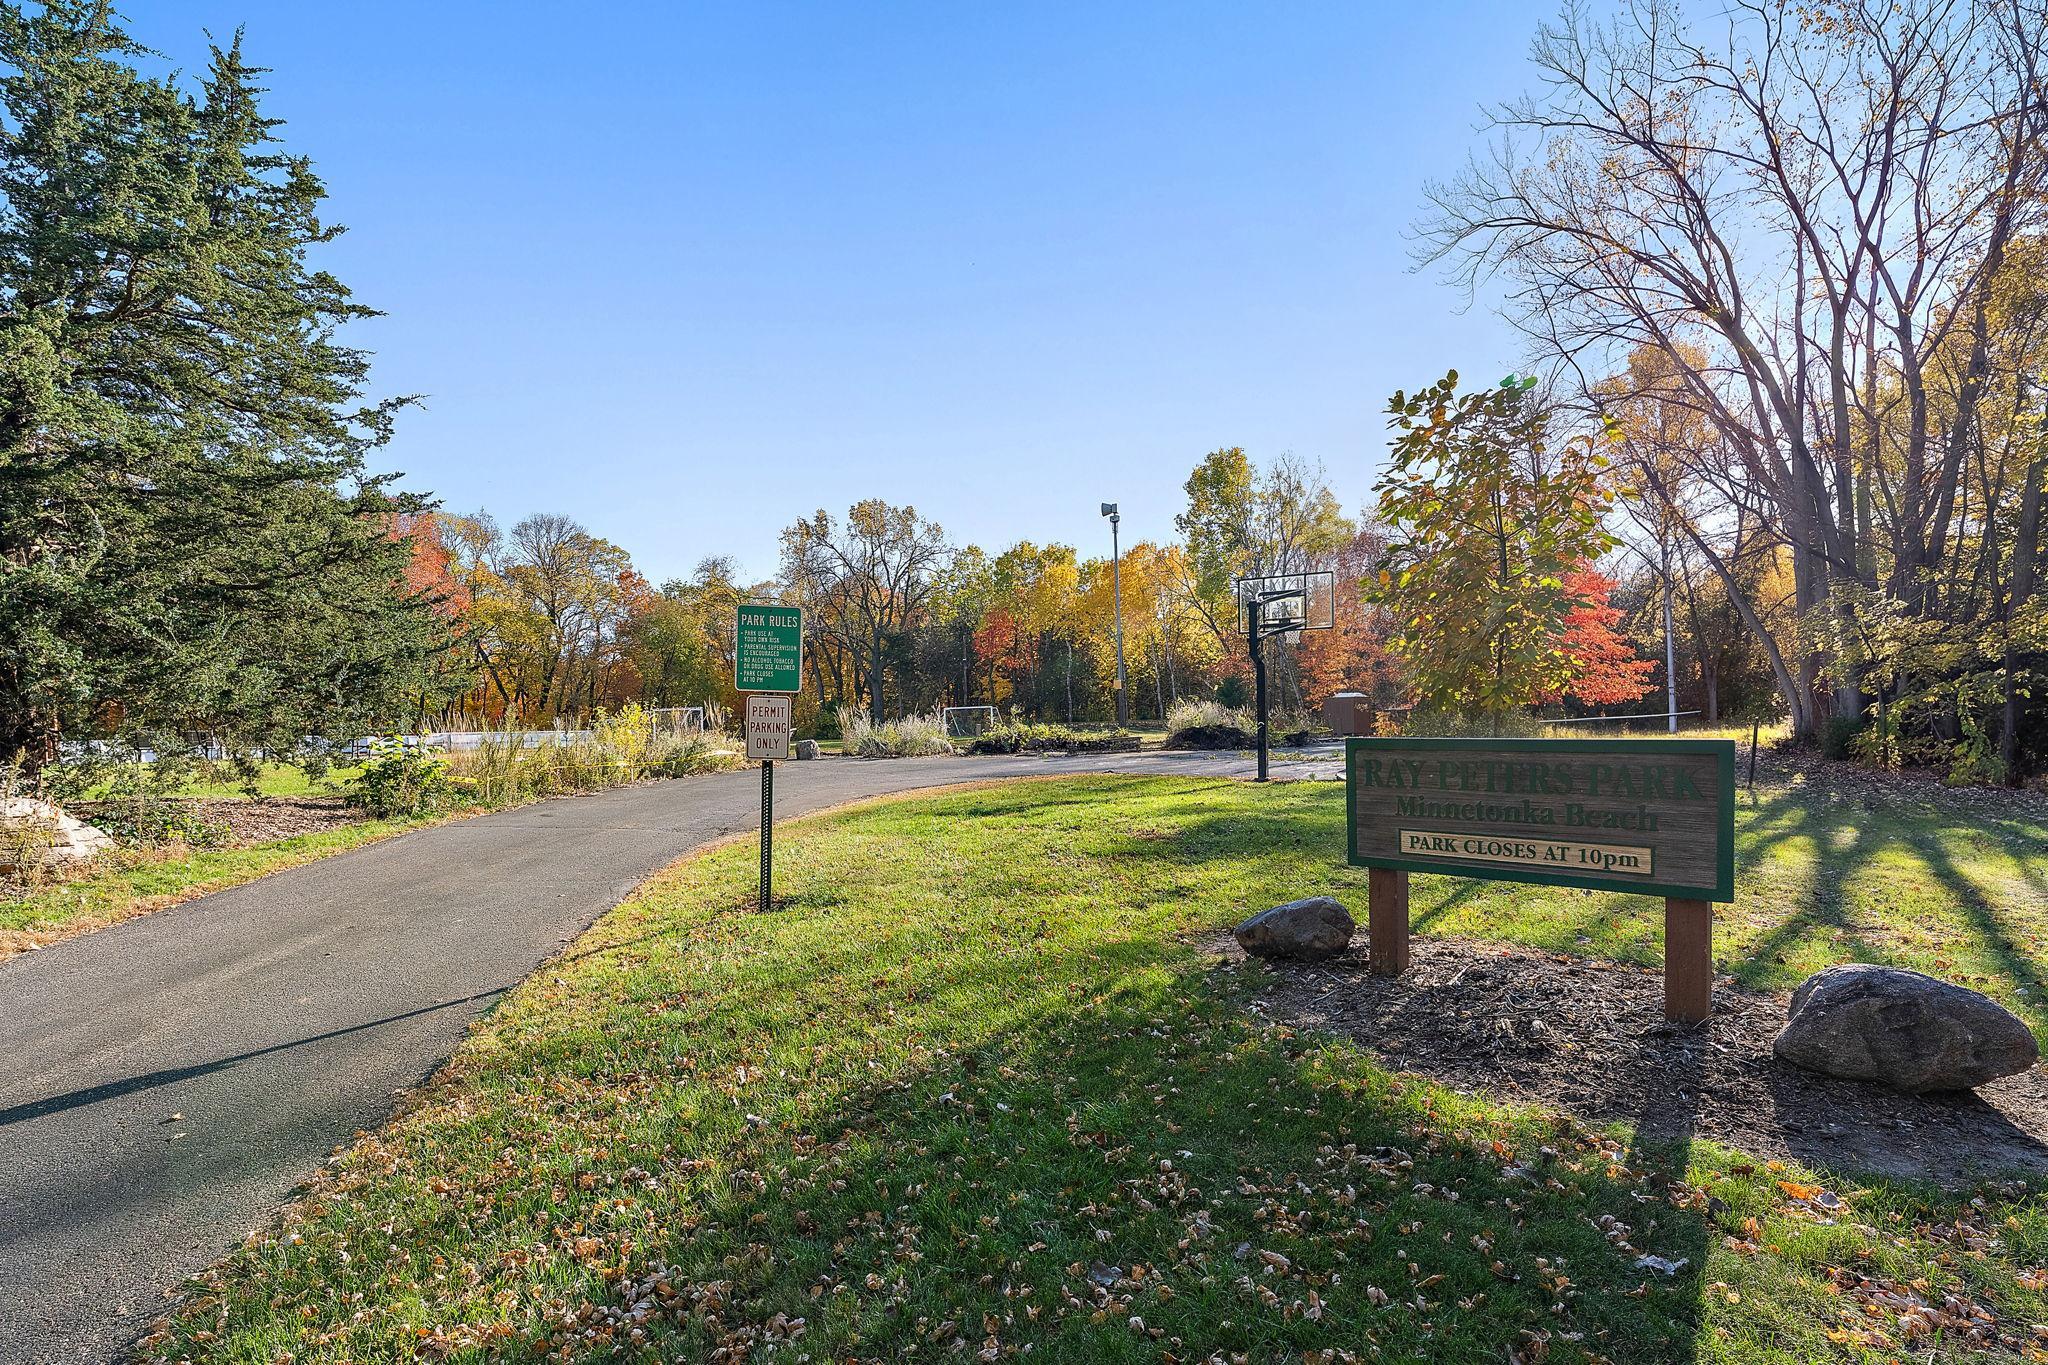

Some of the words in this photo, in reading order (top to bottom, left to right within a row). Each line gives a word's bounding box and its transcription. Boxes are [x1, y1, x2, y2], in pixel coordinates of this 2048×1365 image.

[741, 615, 765, 626] PARK
[770, 616, 798, 628] RULES
[753, 706, 785, 717] PERMIT
[750, 722, 786, 733] PARKING
[756, 738, 779, 749] ONLY
[1363, 758, 1427, 788] RAY
[1438, 760, 1574, 795] PETERS
[1588, 764, 1705, 800] PARK
[1396, 796, 1554, 825] Minnetonka
[1566, 803, 1658, 831] Beach
[1409, 836, 1458, 853] PARK
[1464, 840, 1536, 859] CLOSES
[1544, 846, 1570, 861] AT
[1578, 848, 1639, 869] 10pm
